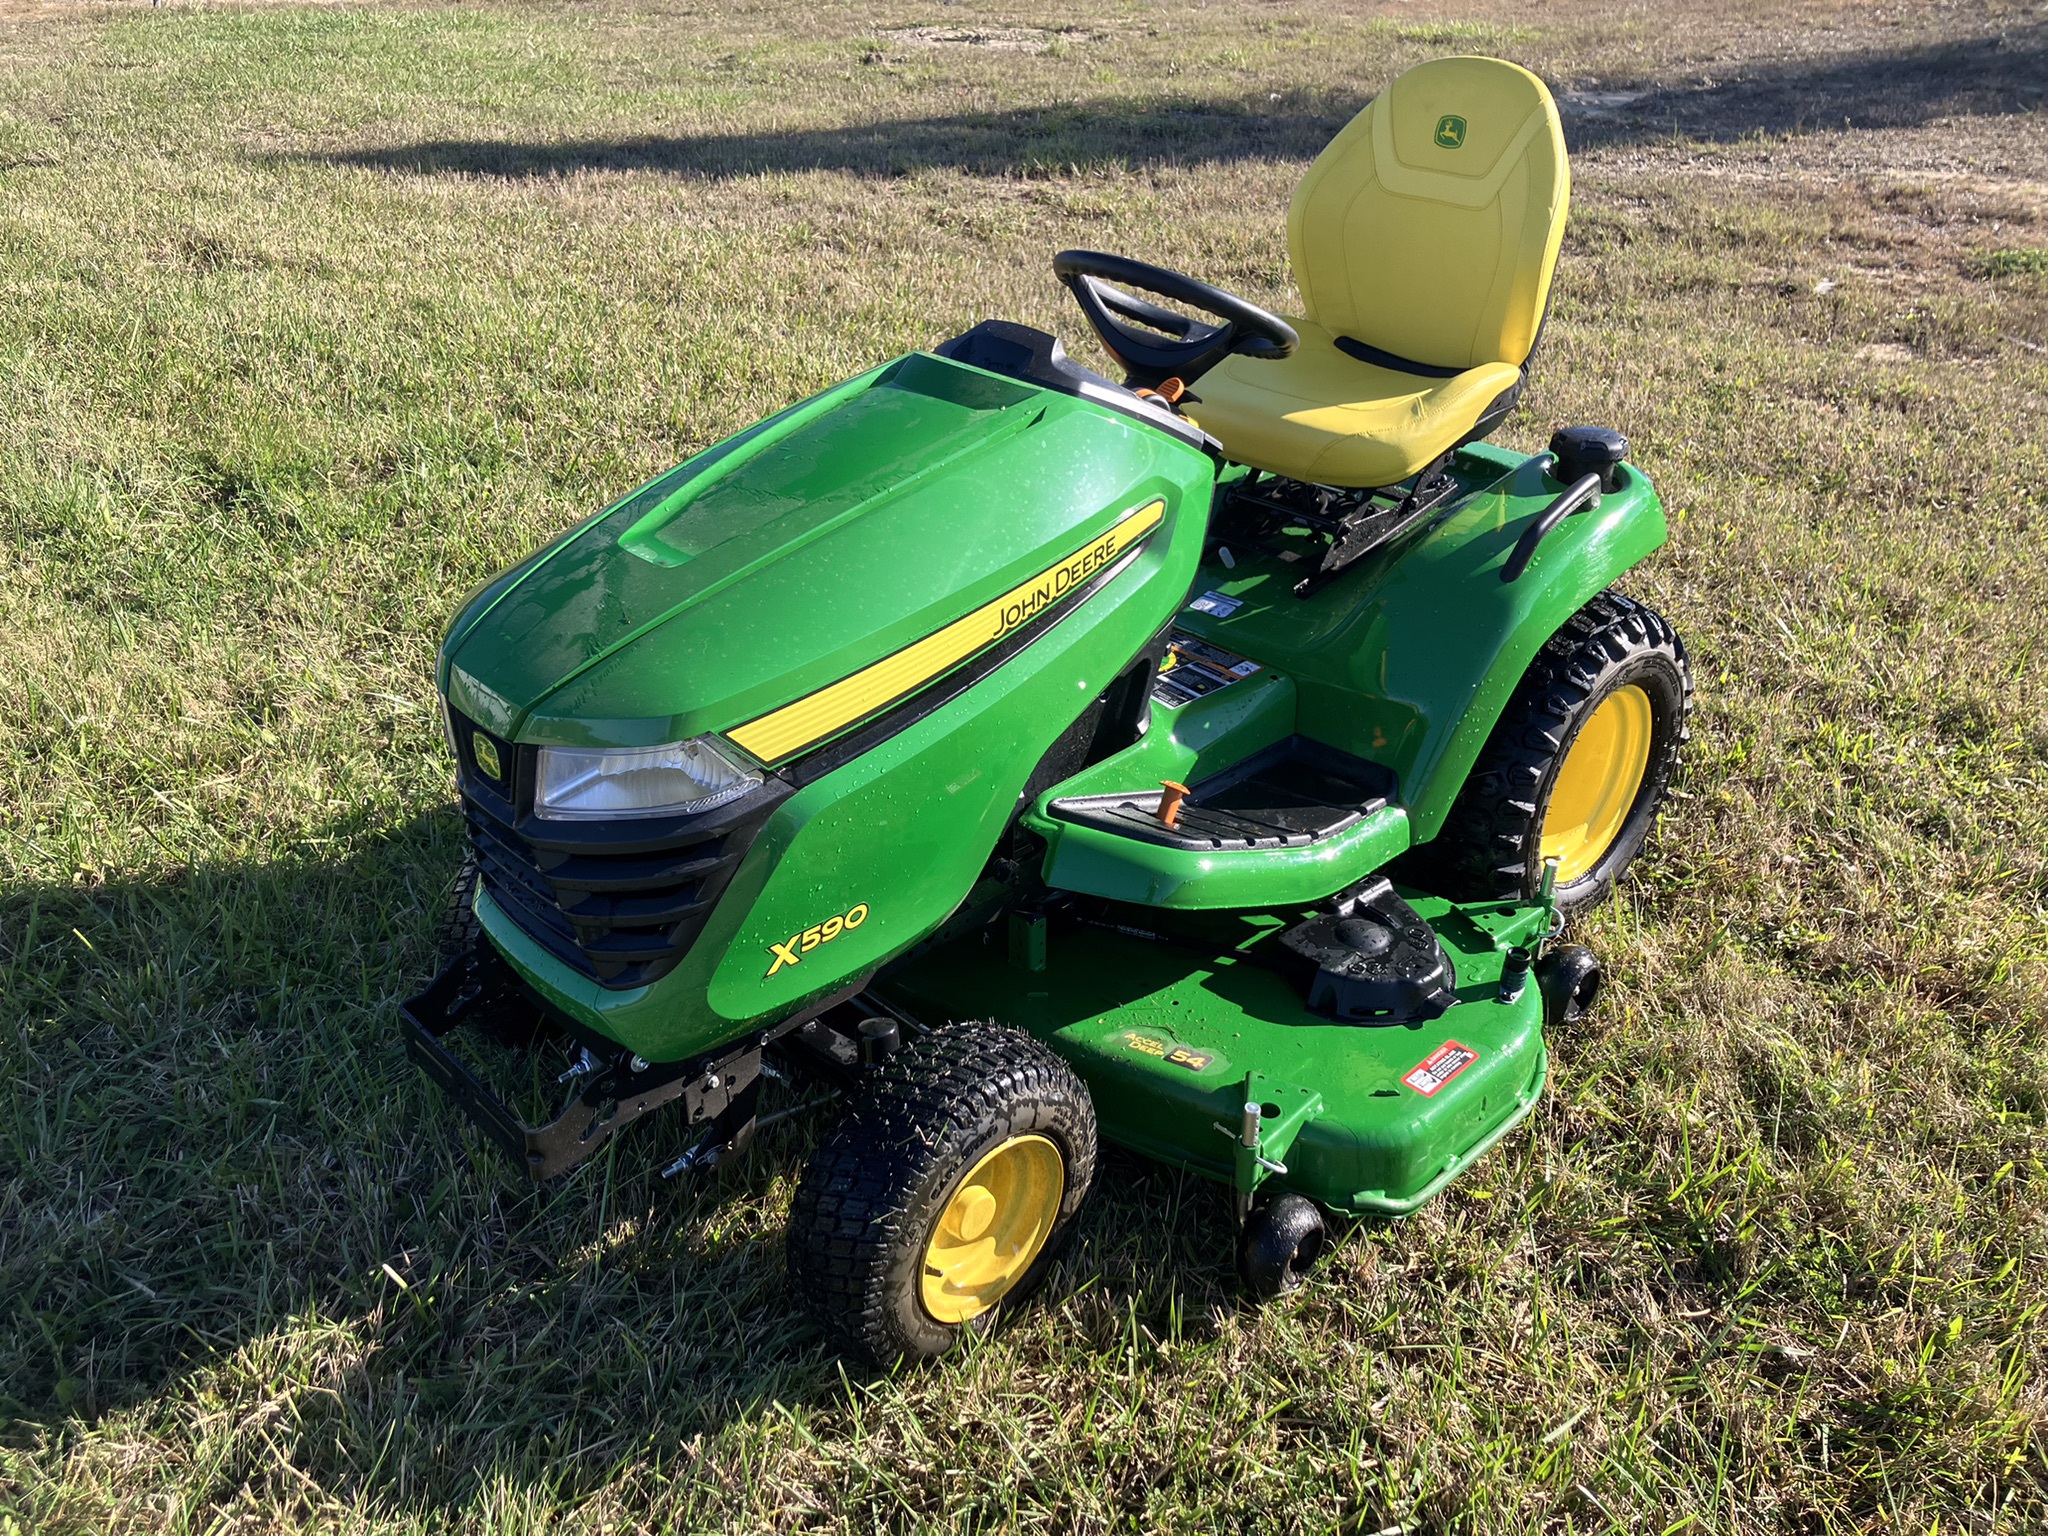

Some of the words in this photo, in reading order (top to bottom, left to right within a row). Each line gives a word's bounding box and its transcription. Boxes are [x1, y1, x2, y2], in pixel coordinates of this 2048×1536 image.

[993, 582, 1050, 637] JOHN
[1055, 535, 1117, 594] DEERE
[764, 903, 869, 978] X590
[1124, 1033, 1164, 1050] ACCEL
[1128, 1041, 1164, 1056] DEEP
[1170, 1050, 1206, 1068] 54
